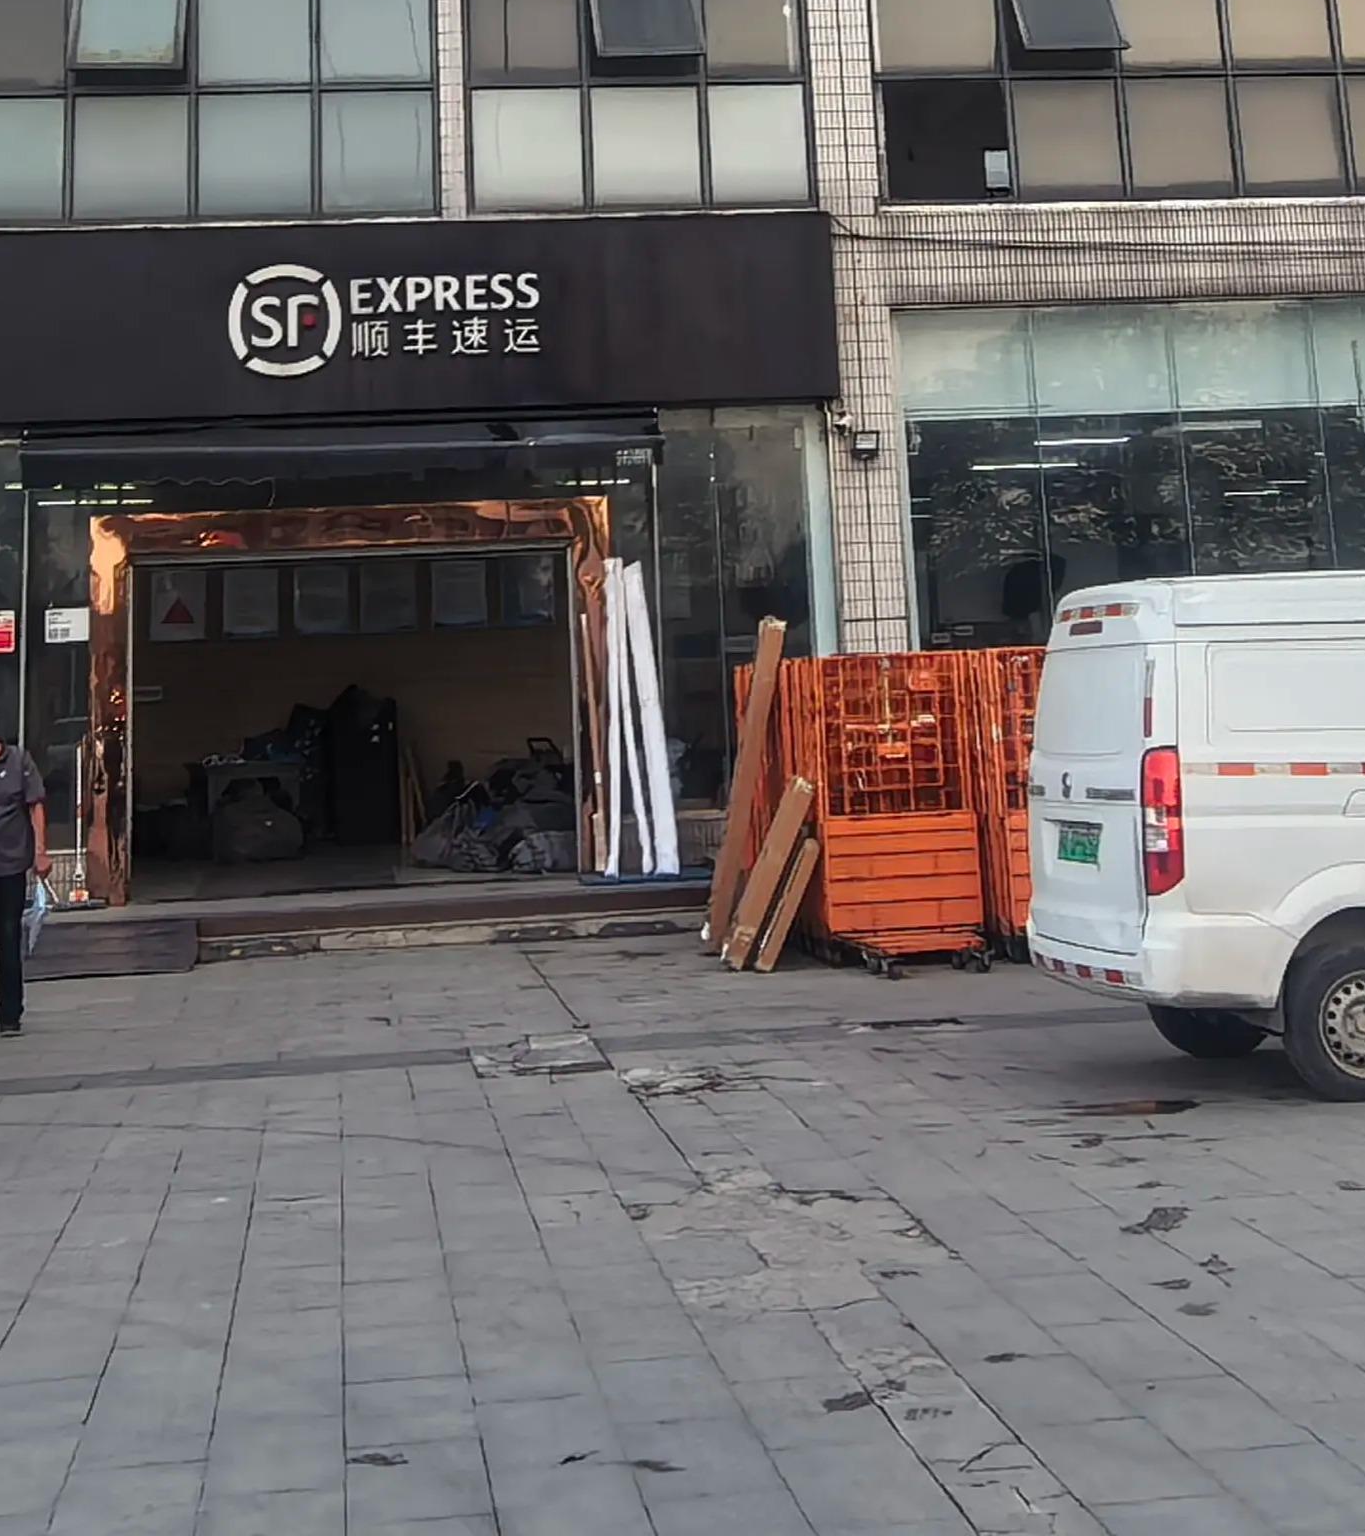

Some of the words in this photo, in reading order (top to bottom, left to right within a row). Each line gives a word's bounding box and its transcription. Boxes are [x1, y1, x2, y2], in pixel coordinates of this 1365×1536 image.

[349, 272, 540, 315] EXPRESS
[350, 317, 541, 357] 顺丰速运
